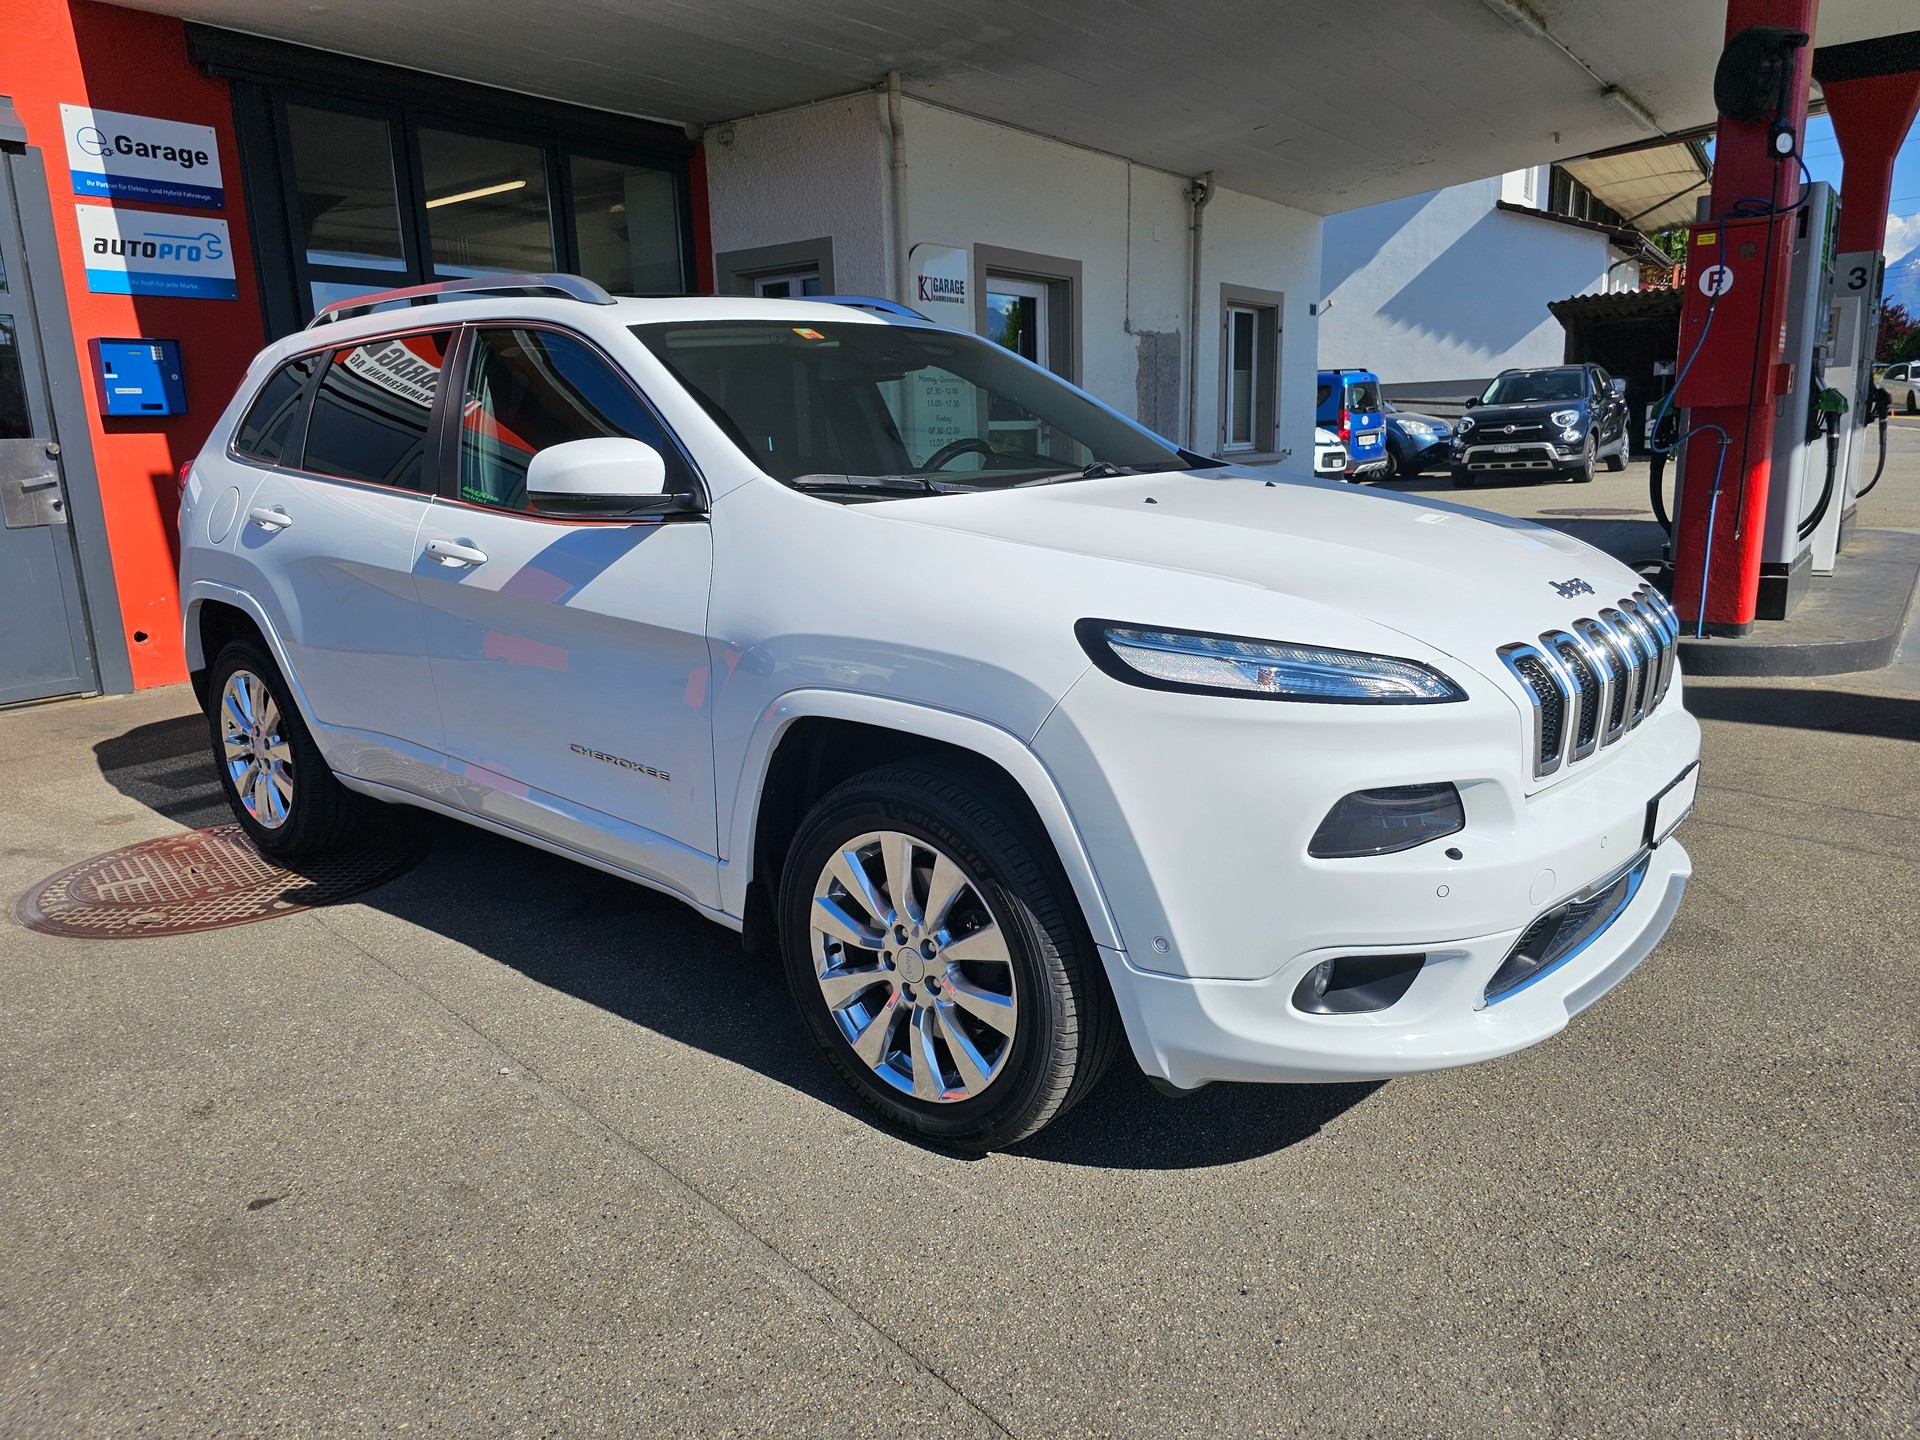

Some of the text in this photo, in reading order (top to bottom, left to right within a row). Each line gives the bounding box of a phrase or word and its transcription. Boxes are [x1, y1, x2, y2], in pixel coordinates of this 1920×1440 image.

[114, 134, 209, 168] Garage
[96, 180, 118, 189] Partner
[1798, 206, 1810, 238] 1
[933, 277, 964, 295] GARAGE
[1708, 270, 1726, 292] F
[1847, 266, 1867, 290] 3
[569, 743, 670, 782] CHEROKEE
